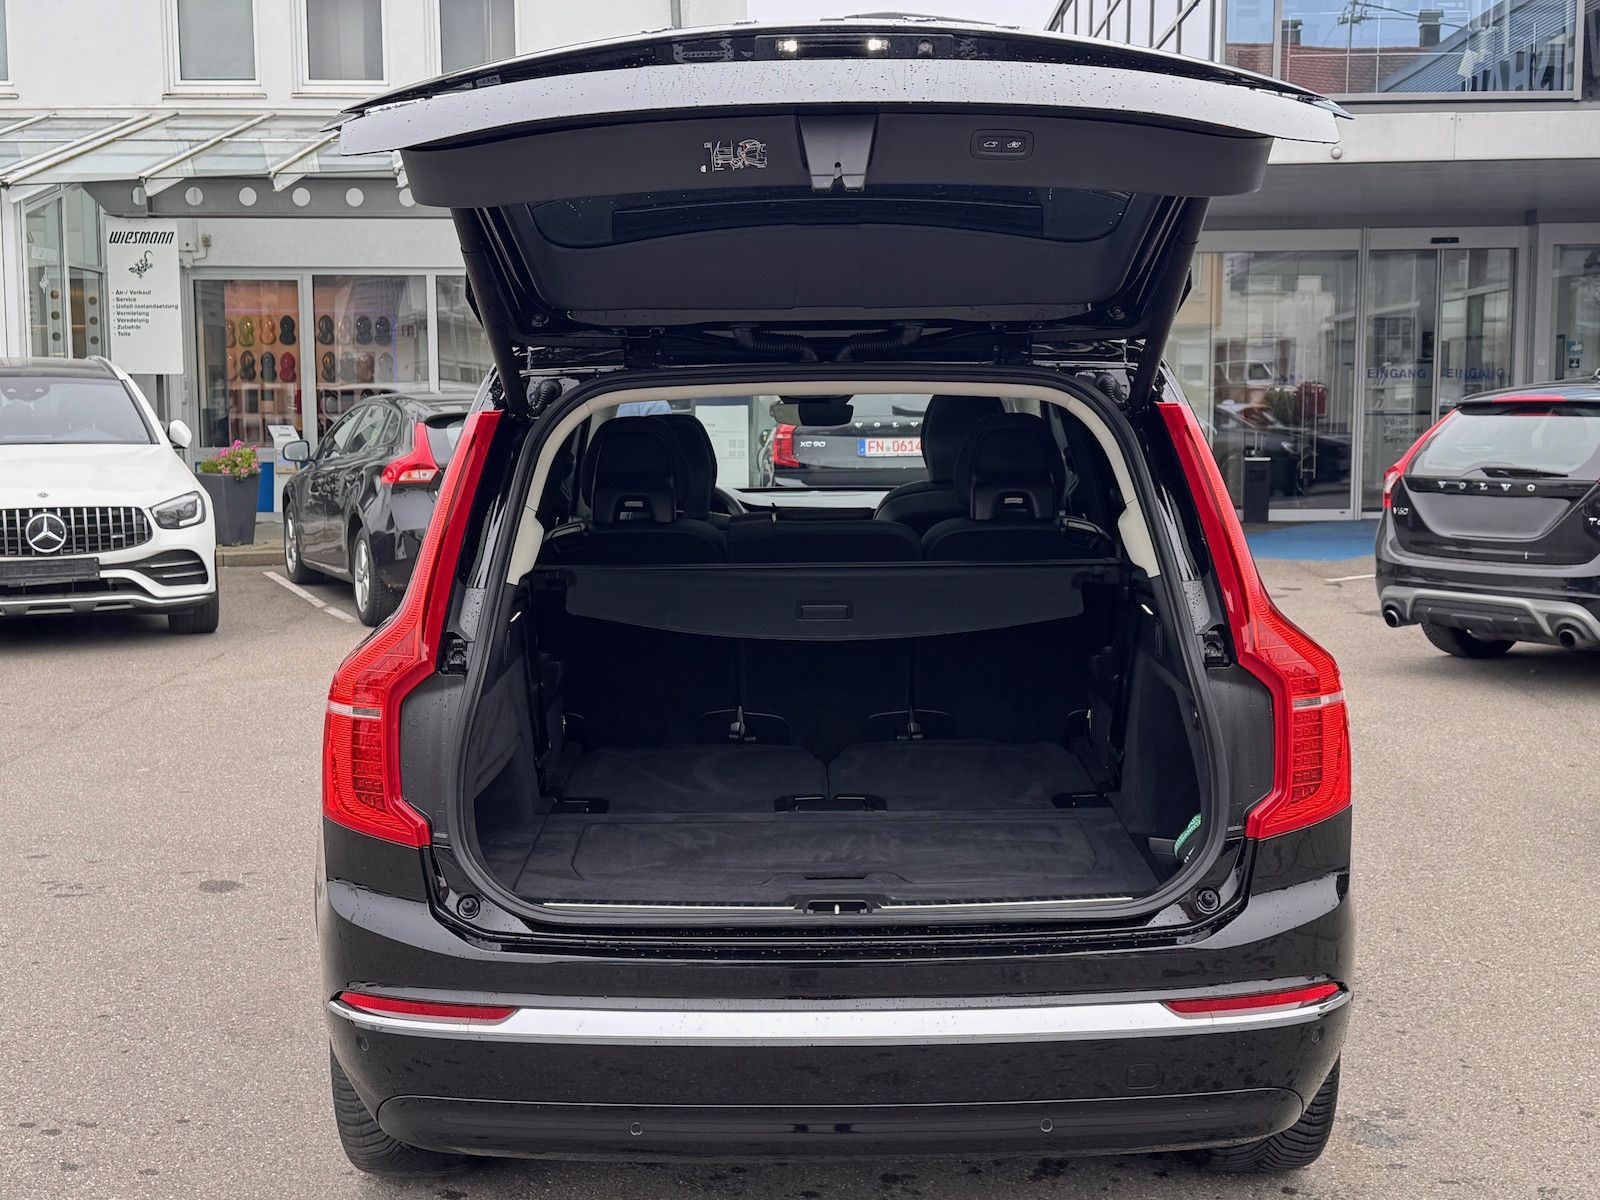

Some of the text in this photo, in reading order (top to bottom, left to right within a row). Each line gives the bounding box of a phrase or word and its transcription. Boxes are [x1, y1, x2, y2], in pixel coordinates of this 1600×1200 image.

[1367, 368, 1426, 379] EINGANG
[1447, 368, 1506, 380] EINGANG
[854, 421, 920, 429] VOLV
[1383, 417, 1409, 425] Vovo
[1383, 425, 1423, 434] Personal
[800, 440, 826, 448] XC90
[868, 441, 884, 452] FN
[1437, 480, 1536, 493] VOLVO
[1392, 506, 1409, 516] V60
